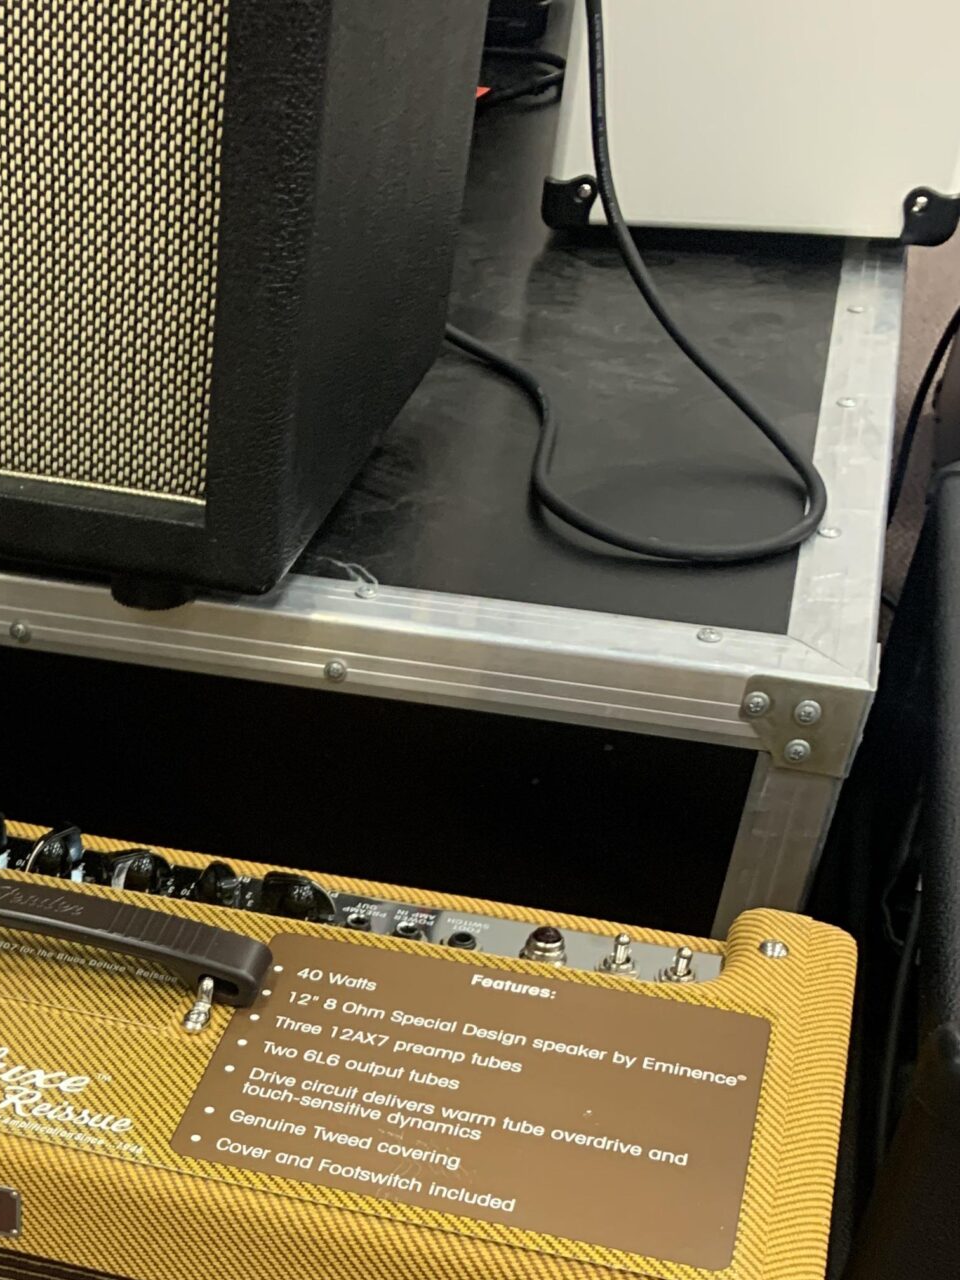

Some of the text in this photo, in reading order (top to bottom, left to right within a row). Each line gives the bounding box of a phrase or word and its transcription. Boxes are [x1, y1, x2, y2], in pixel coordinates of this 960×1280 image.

[342, 906, 387, 919] PREAMP
[356, 902, 378, 911] OUT
[411, 911, 437, 920] AMP
[393, 914, 435, 926] POWER
[447, 917, 490, 930] SWITCH
[20, 944, 36, 954] for
[37, 948, 54, 959] the
[56, 953, 87, 966] Blues
[296, 967, 378, 992] 40 Watts
[470, 973, 558, 1000] Features:
[289, 991, 320, 1006] 12"
[323, 998, 337, 1011] 8
[342, 1001, 386, 1020] Ohm
[390, 1010, 458, 1034] Special
[461, 1023, 527, 1047] Design
[532, 1036, 608, 1062] speaker
[612, 1050, 637, 1069] by
[274, 1015, 523, 1074] Three 12AX7 preamp tubes
[263, 1040, 461, 1091] Two 6L6 output tubes
[242, 1081, 483, 1142] touch-sensitive dynamics
[248, 1066, 689, 1168] Drive circuit delivers warm tube overdrive and
[3, 1115, 75, 1139] Amplification
[229, 1109, 462, 1172] Genuine Tweed covering
[216, 1137, 517, 1214] Cover and Footswitch included
